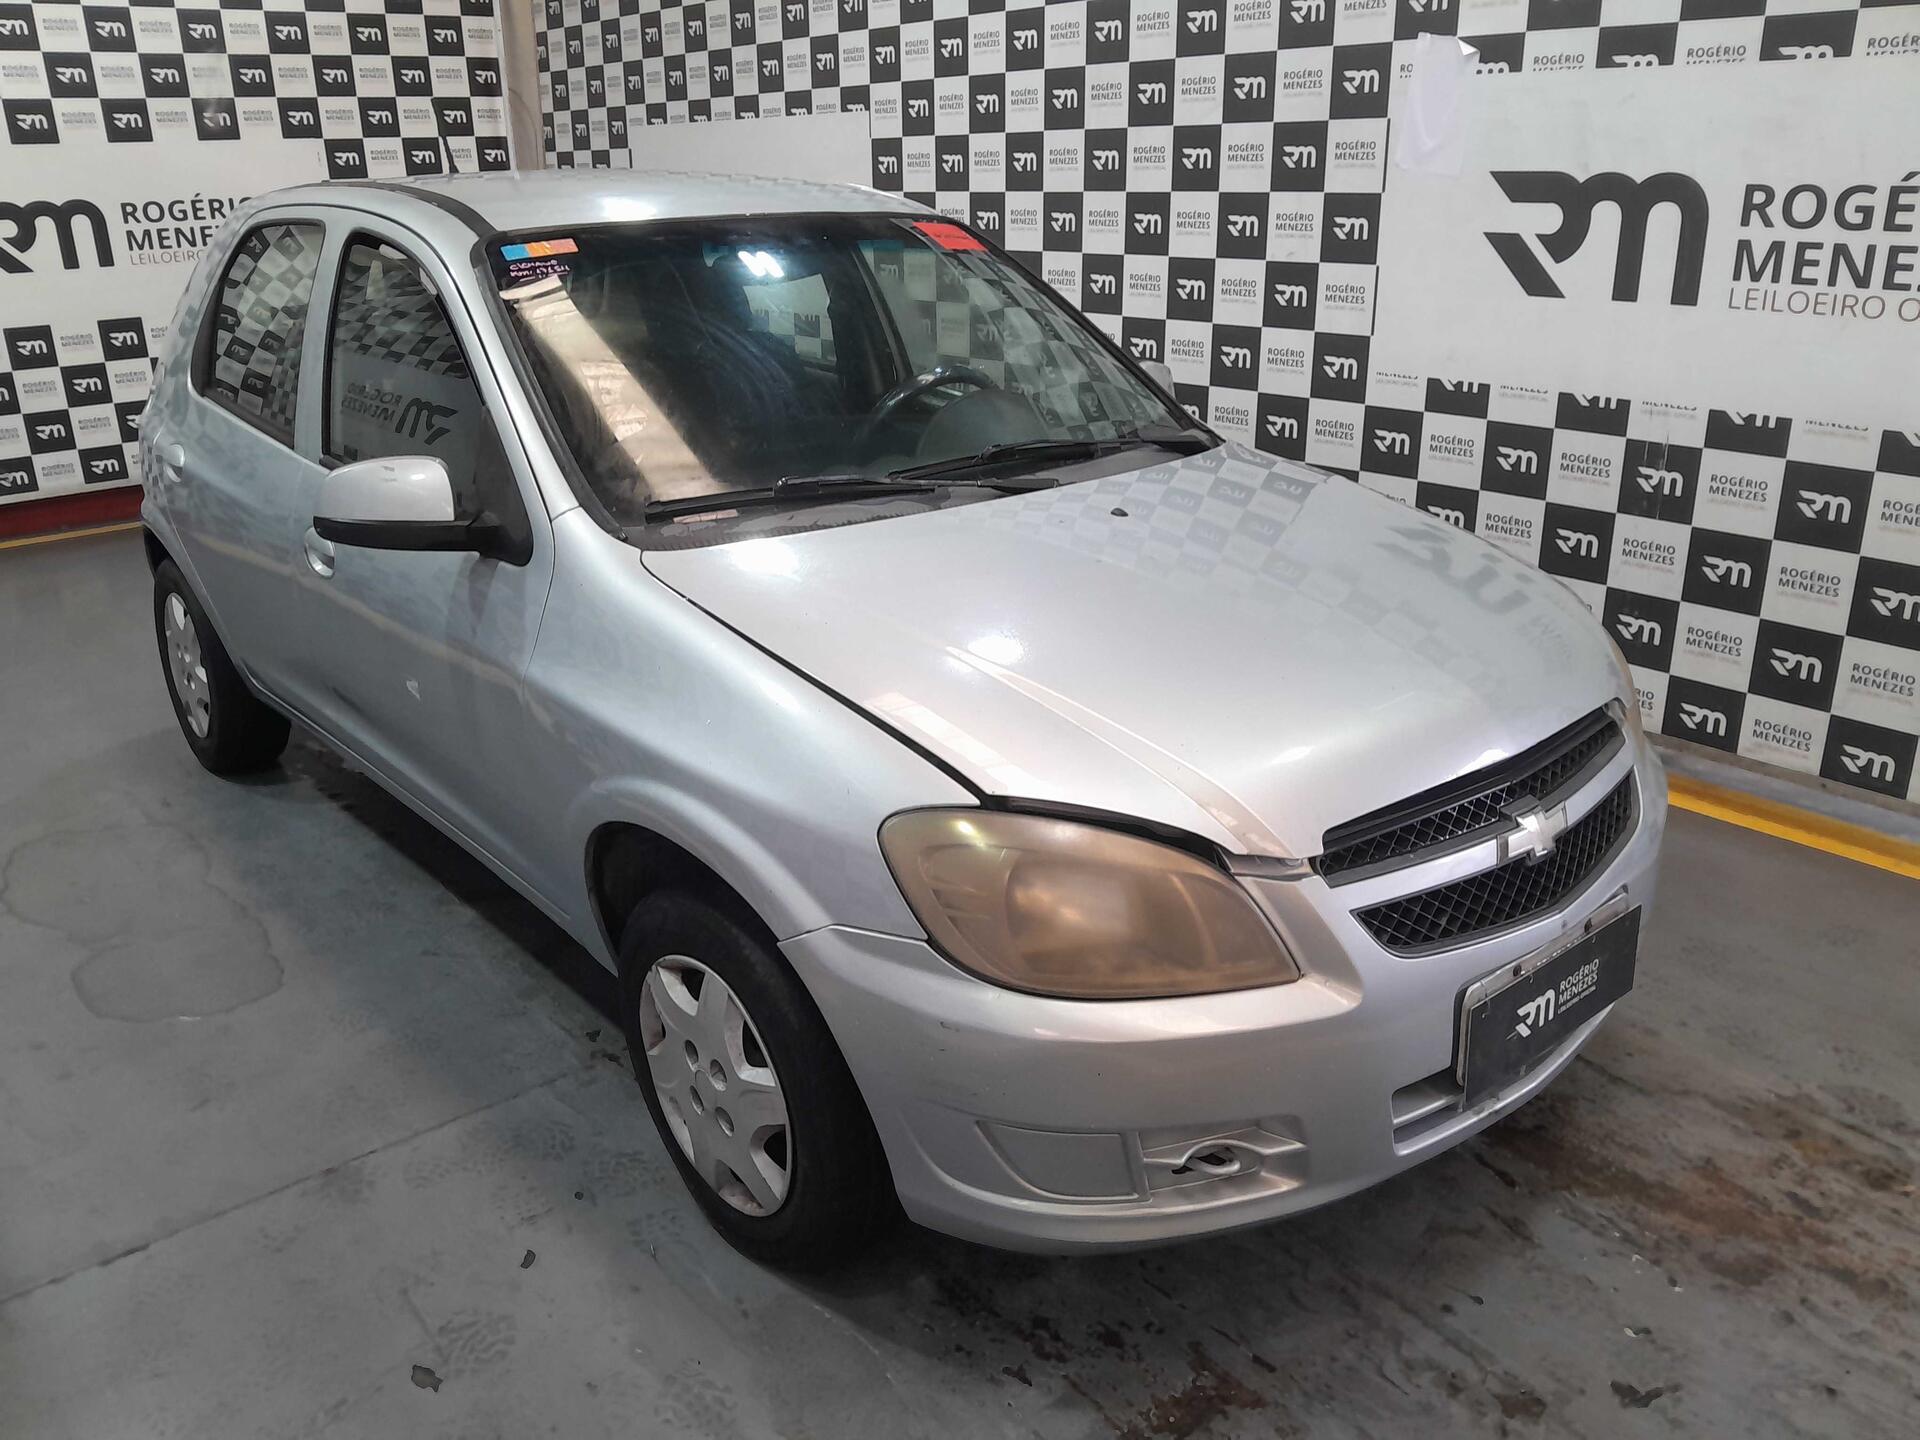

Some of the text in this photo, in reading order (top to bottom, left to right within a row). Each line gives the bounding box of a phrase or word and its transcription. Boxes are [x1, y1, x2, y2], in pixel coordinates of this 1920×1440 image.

[1234, 0, 1272, 12] ROGÉRIO
[1137, 12, 1170, 22] ROGÉRIO
[1234, 11, 1271, 22] MENEZES
[1051, 22, 1080, 31] ROGÉRIO
[1137, 21, 1170, 31] MENEZES
[974, 31, 1000, 40] ROGÉRIO
[1051, 30, 1080, 40] MENEZES
[974, 39, 1000, 48] MENEZES
[1687, 44, 1747, 59] ROGÉRIO
[1533, 53, 1585, 66] ROGÉRIO
[1284, 69, 1323, 80] ROGÉRIO
[1182, 76, 1216, 86] ROGÉRIO
[1284, 80, 1322, 90] MENEZES
[1092, 82, 1122, 92] ROGÉRIO
[1182, 86, 1216, 96] MENEZES
[1011, 88, 1038, 97] ROGÉRIO
[1091, 92, 1122, 100] MENEZES
[1011, 97, 1038, 106] MENEZES
[1228, 143, 1264, 152] ROGÉRIO
[1336, 140, 1376, 150] ROGÉRIO
[974, 149, 1002, 158] ROGÉRIO
[1228, 153, 1264, 162] MENEZES
[1335, 152, 1376, 160] MENEZES
[974, 158, 1002, 166] MENEZES
[1740, 171, 1920, 233] ROGÉ
[1089, 209, 1119, 218] ROGÉRIO
[1177, 210, 1210, 220] ROGÉRIO
[1276, 212, 1314, 222] ROGÉRIO
[1089, 219, 1119, 227] MENEZES
[1177, 221, 1210, 229] MENEZES
[1276, 223, 1314, 232] MENEZES
[1732, 239, 1920, 292] MENE
[1130, 273, 1161, 283] ROGÉRIO
[1222, 278, 1256, 288] ROGÉRIO
[1130, 282, 1160, 291] MENEZES
[1326, 284, 1365, 294] ROGÉRIO
[1221, 288, 1256, 298] MENEZES
[1325, 294, 1365, 304] MENEZES
[1728, 288, 1886, 320] LEILOEIRO
[1172, 339, 1204, 349] ROGÉRIO
[1171, 348, 1204, 358] MENEZES
[1268, 348, 1304, 358] ROGÉRIO
[1267, 357, 1304, 368] MENEZES
[1215, 406, 1249, 417] ROGÉRIO
[1215, 414, 1248, 426] MENEZES
[1316, 419, 1354, 431] ROGÉRIO
[1315, 428, 1354, 441] MENEZES
[1431, 434, 1474, 448] ROGÉRIO
[1430, 444, 1474, 458] MENEZES
[1562, 452, 1611, 468] ROGÉRIO
[1560, 463, 1610, 478] MENEZES
[1711, 474, 1768, 491] ROGÉRIO
[1709, 485, 1766, 502] MENEZES
[1486, 513, 1532, 529] ROGÉRIO
[1485, 523, 1531, 539] MENEZES
[1624, 538, 1676, 555] ROGÉRIO
[1622, 548, 1674, 566] MENEZES
[1780, 567, 1841, 586] ROGÉRIO
[1778, 578, 1839, 597] MENEZES
[1688, 626, 1742, 646] ROGÉRIO
[1686, 637, 1741, 657] MENEZES
[1852, 663, 1916, 685] ROGÉRIO
[1850, 674, 1914, 696] MENEZES
[1754, 719, 1812, 741] ROGÉRIO
[1753, 729, 1810, 752] MENEZES
[1560, 958, 1599, 993] ROGÉRIO
[1558, 971, 1599, 1005] MENEZES
